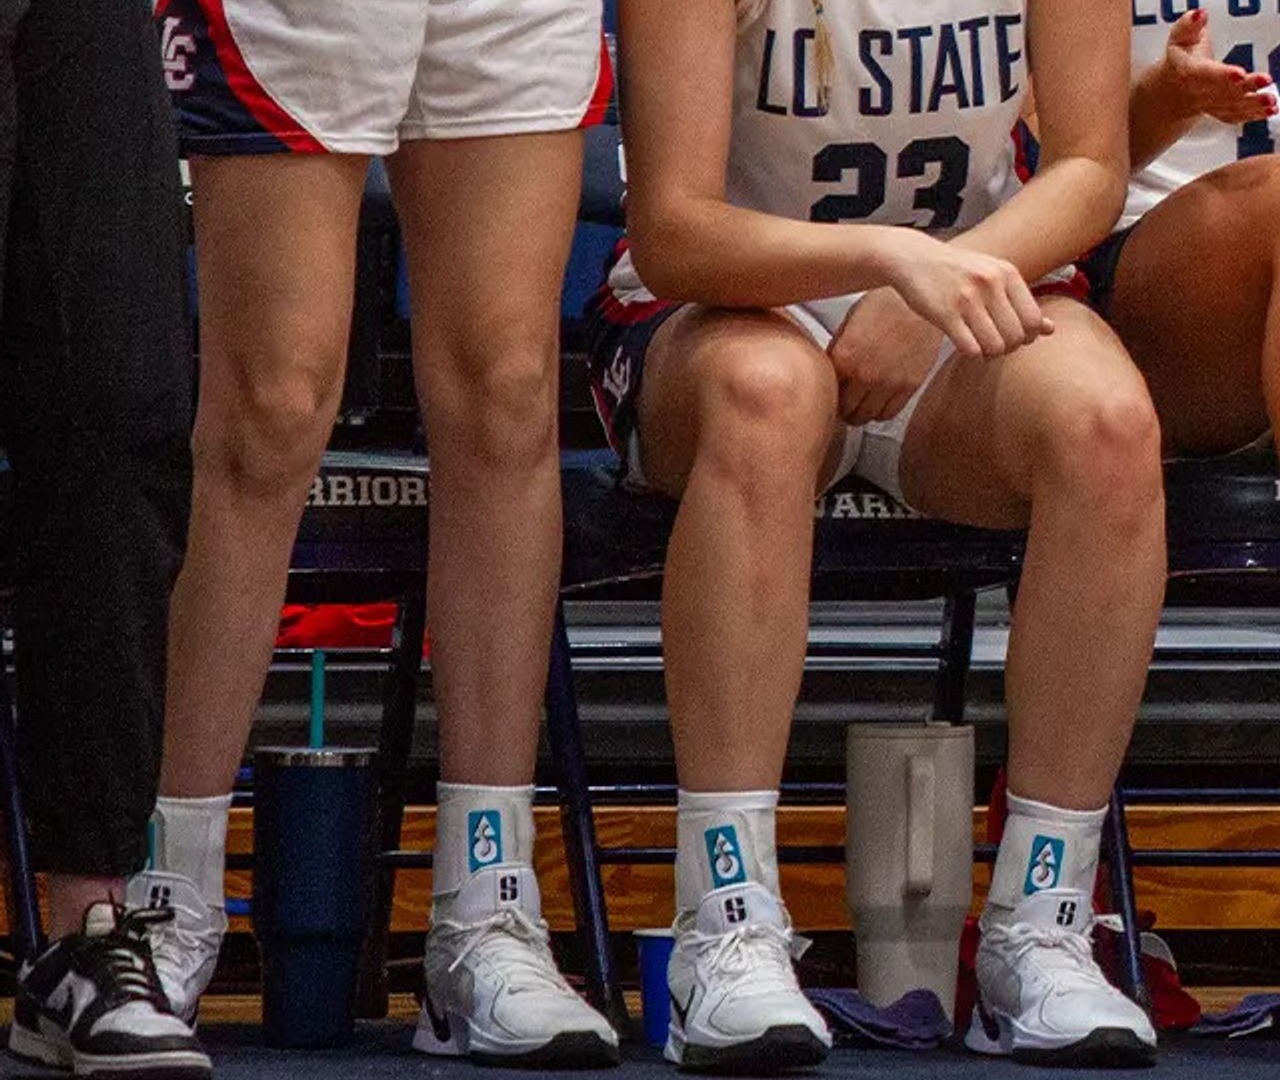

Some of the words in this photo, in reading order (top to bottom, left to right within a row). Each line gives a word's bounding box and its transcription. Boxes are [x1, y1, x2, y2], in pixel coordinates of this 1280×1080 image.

[857, 13, 1022, 117] STATE
[808, 135, 970, 229] 23
[304, 474, 428, 506] RRIOR
